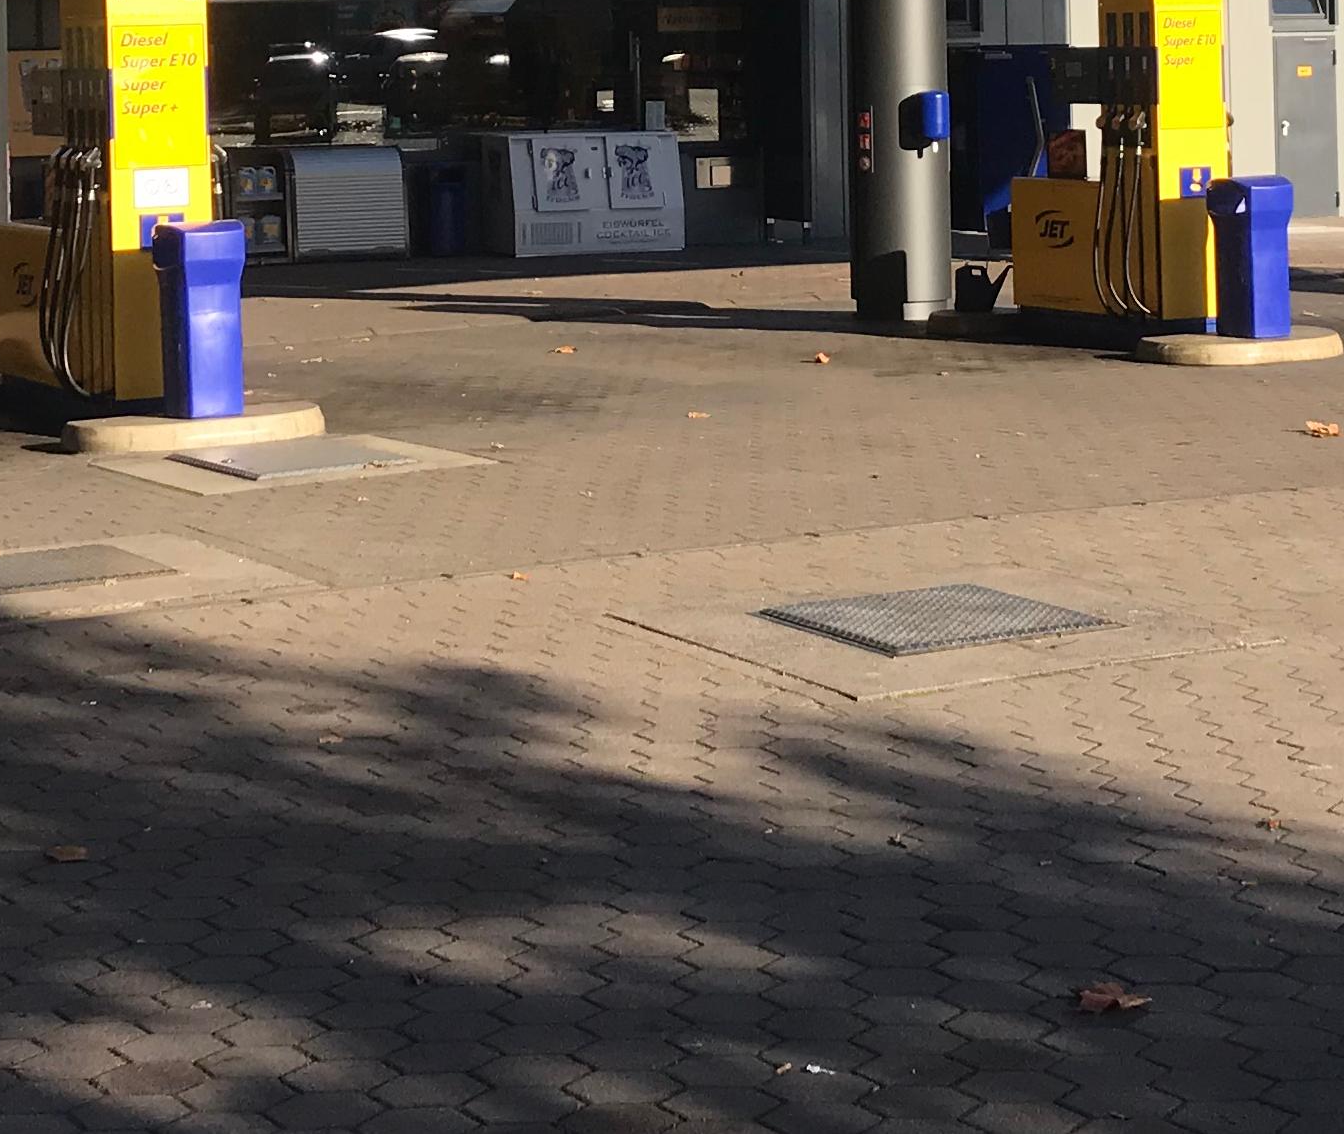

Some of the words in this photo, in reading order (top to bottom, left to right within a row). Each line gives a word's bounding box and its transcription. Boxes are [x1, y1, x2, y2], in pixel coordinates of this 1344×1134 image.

[1163, 17, 1197, 29] Diesel
[120, 32, 169, 47] Diesel
[1164, 36, 1194, 49] Super
[1197, 34, 1217, 46] E10
[121, 55, 166, 71] Super
[169, 53, 198, 67] E10
[1164, 53, 1195, 69] Super
[121, 78, 167, 95] Super
[122, 102, 166, 118] Super
[1039, 220, 1070, 239] JET
